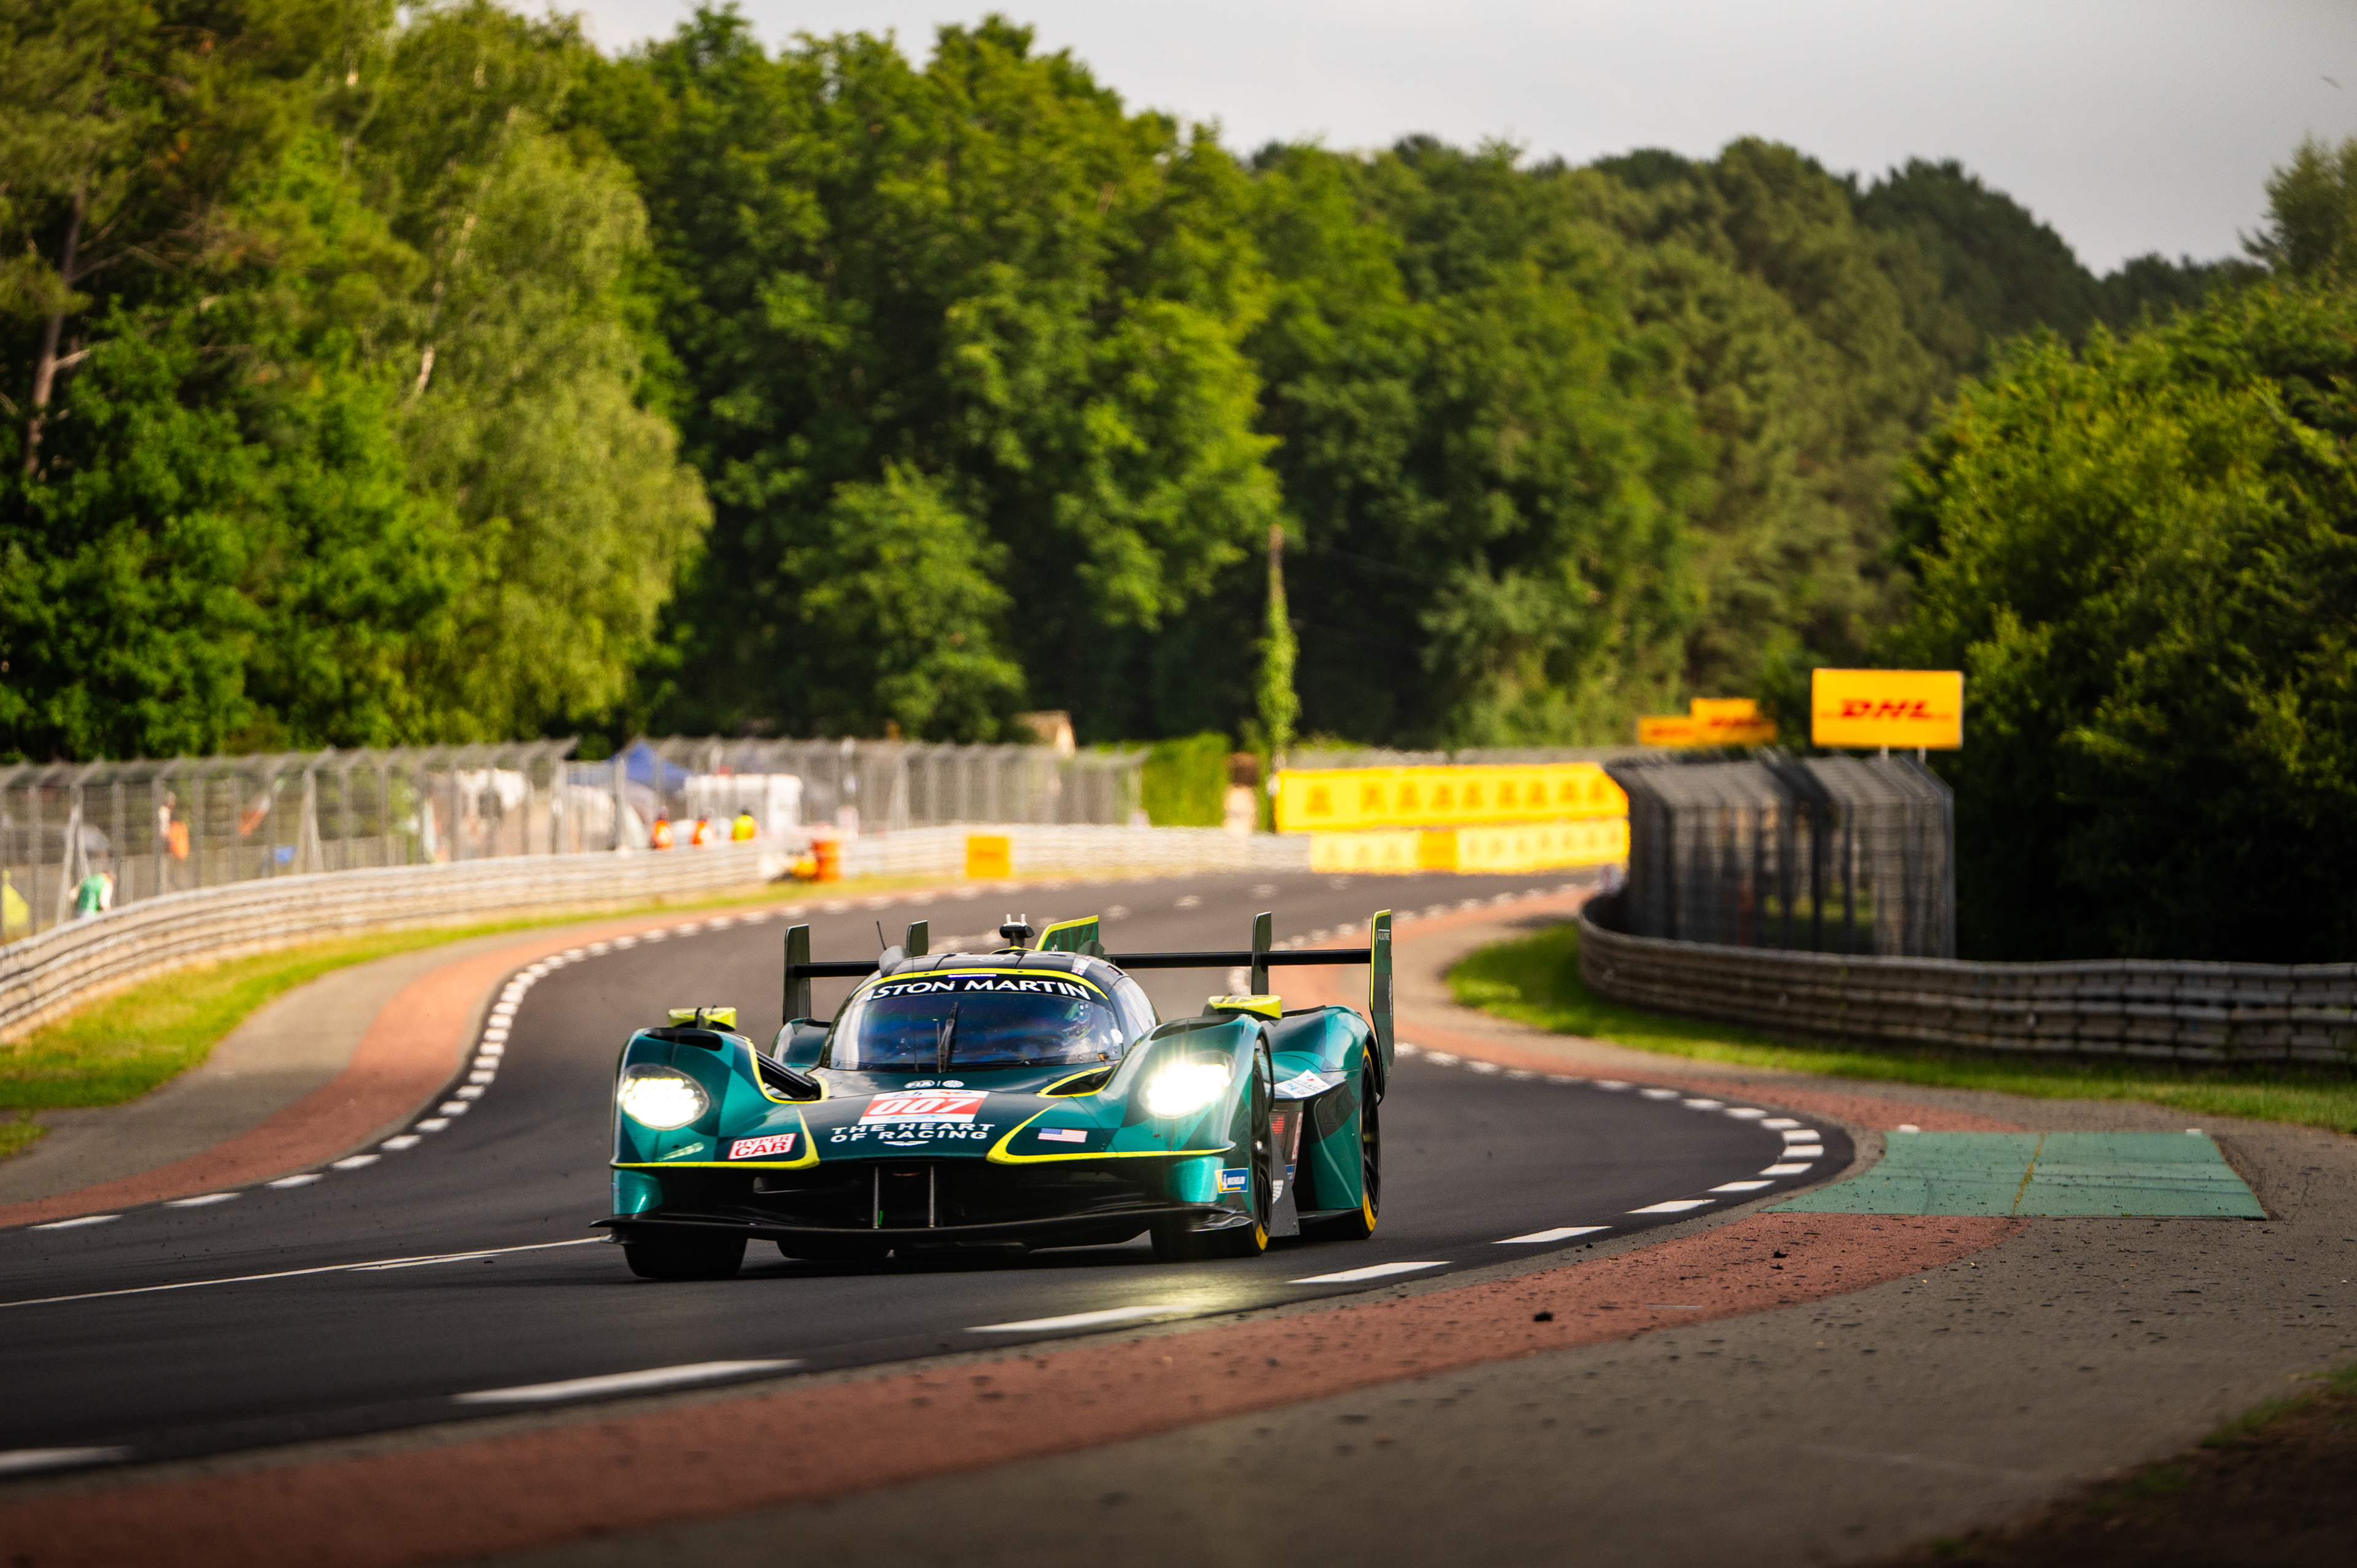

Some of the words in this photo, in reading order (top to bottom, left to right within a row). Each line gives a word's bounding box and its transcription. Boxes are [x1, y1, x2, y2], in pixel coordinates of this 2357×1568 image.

[1840, 698, 1932, 720] DHL
[857, 981, 956, 1003] ASTON
[964, 980, 1091, 1000] MARTIN
[869, 1098, 979, 1115] 007
[831, 1124, 888, 1135] THE
[897, 1122, 996, 1132] HEART
[737, 1135, 789, 1147] HYPER
[830, 1132, 868, 1143] OF
[877, 1130, 988, 1140] RACING
[734, 1141, 787, 1156] CAR
